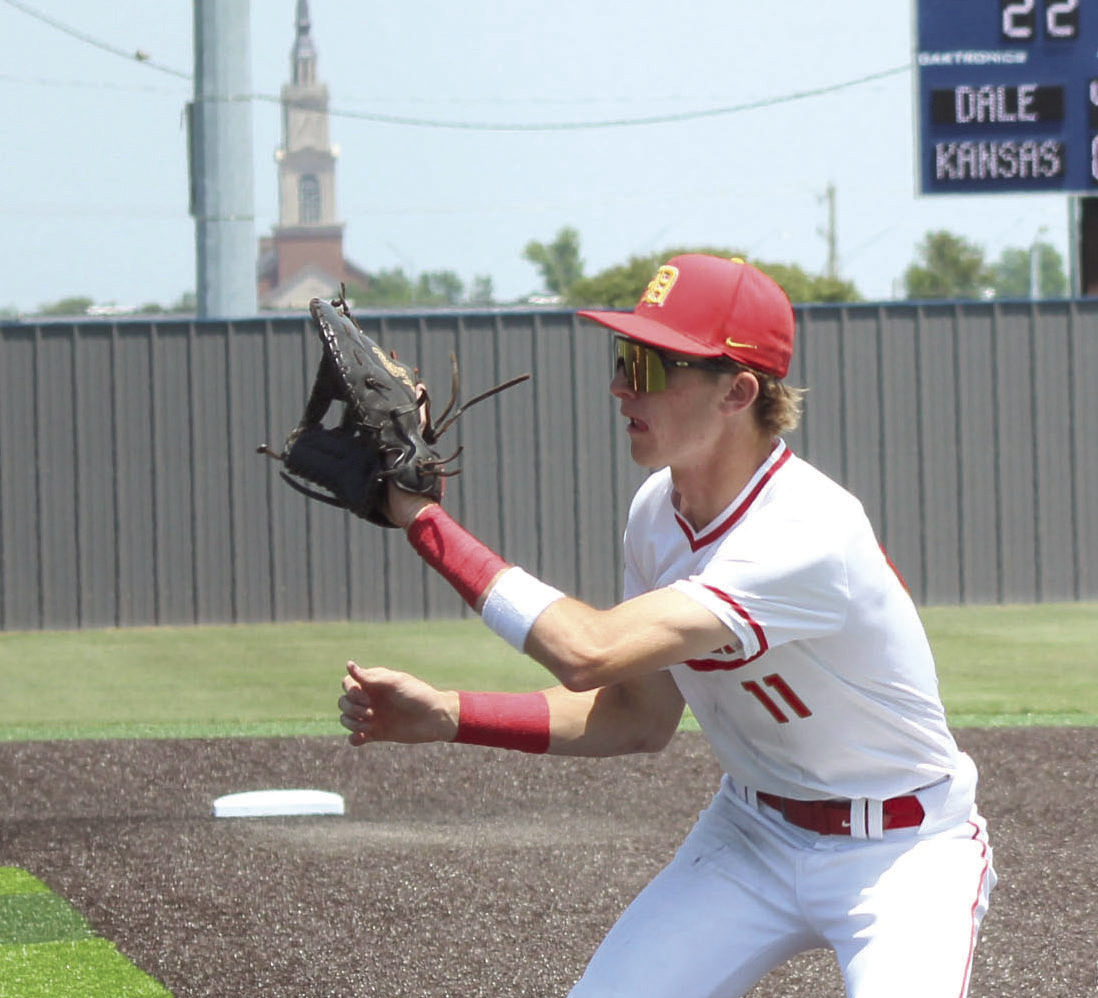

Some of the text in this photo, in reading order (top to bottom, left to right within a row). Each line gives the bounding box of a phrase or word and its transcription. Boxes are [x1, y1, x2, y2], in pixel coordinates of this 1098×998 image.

[955, 84, 1037, 123] DALE
[936, 140, 1061, 180] KANSAS
[741, 673, 812, 723] 11
